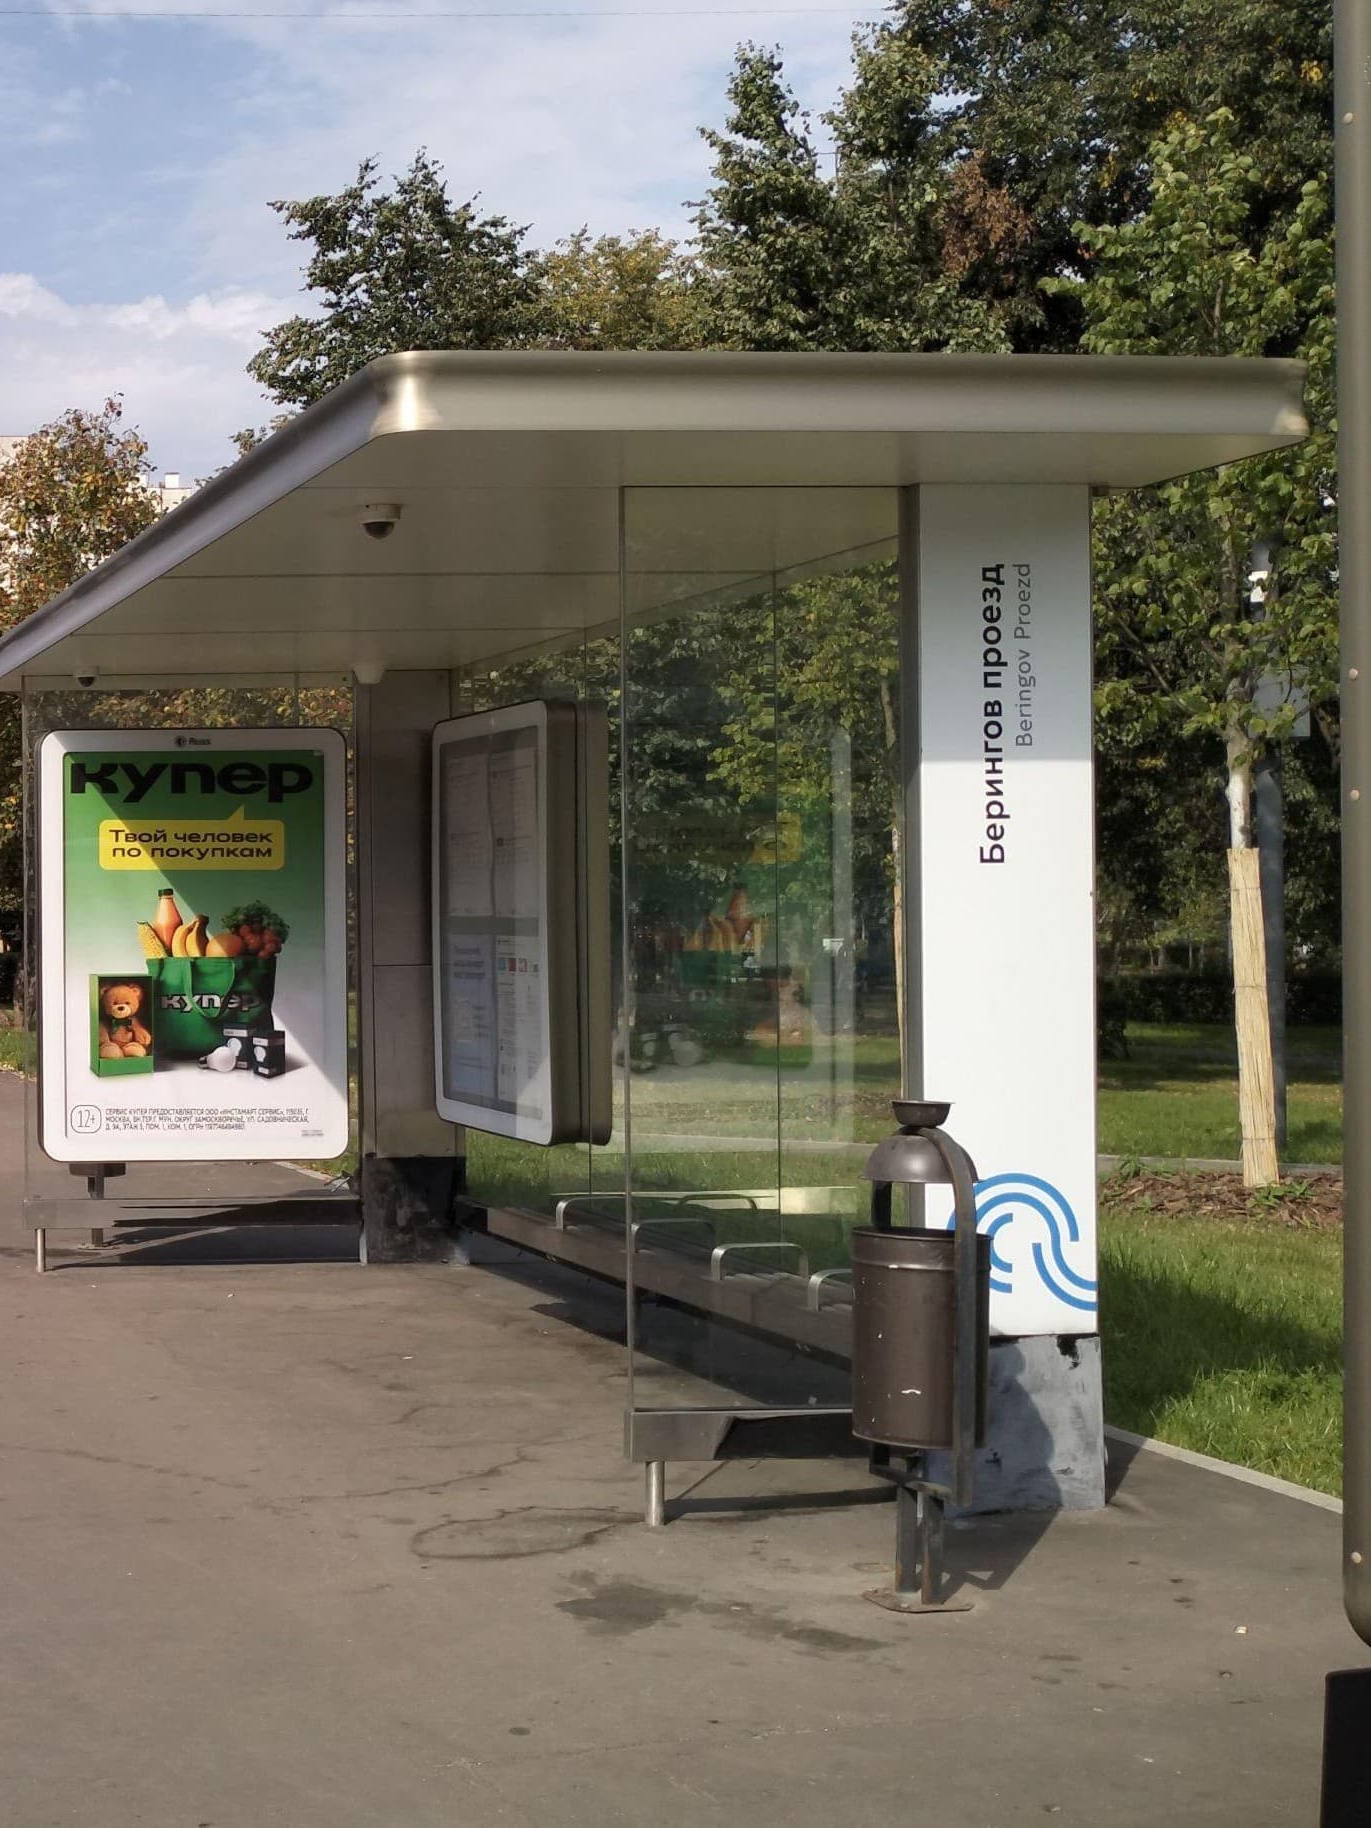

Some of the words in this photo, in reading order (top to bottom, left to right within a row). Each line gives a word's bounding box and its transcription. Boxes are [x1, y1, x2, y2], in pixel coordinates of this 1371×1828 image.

[981, 563, 1008, 688] проезд
[1012, 563, 1030, 639] Proezd
[1014, 649, 1036, 747] Beringov
[70, 762, 314, 804] купер
[979, 699, 1010, 864] Берингов
[109, 828, 168, 844] Твой
[174, 831, 273, 844] человек
[112, 846, 142, 858] по
[150, 846, 273, 860] покупкам
[77, 1109, 96, 1128] 12+
